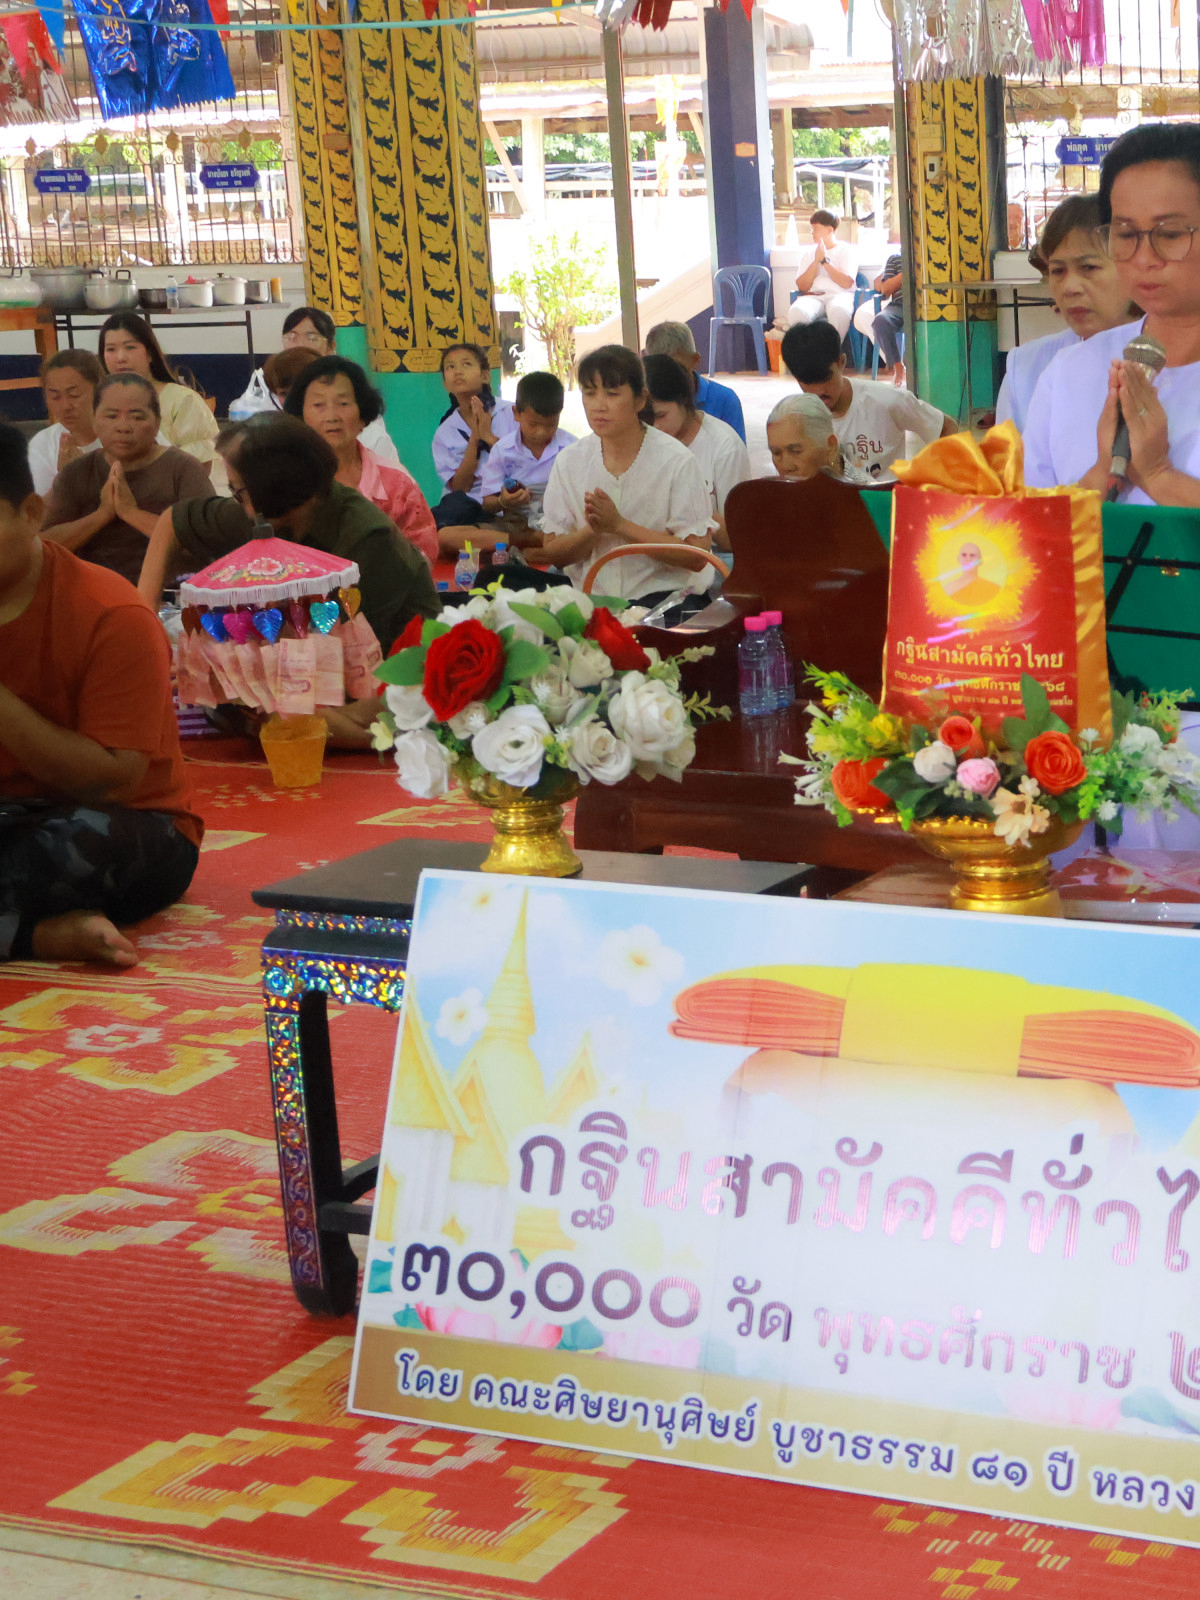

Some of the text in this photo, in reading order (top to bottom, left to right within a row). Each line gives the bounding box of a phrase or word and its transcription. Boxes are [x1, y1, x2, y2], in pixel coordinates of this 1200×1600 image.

[896, 636, 1064, 669] กฐินสามัคคีทั่วไทย
[400, 1242, 702, 1329] ๓๐,๐๐๐
[727, 1275, 792, 1343] วัด
[813, 1303, 1136, 1390] พุทธศักราช
[398, 1352, 459, 1398] โดย
[473, 1377, 757, 1444] คณะศิษยานุศิษย์
[772, 1420, 955, 1474] บูชาธรรม
[972, 1452, 1029, 1487] ๘๑
[1047, 1451, 1074, 1492] ปี
